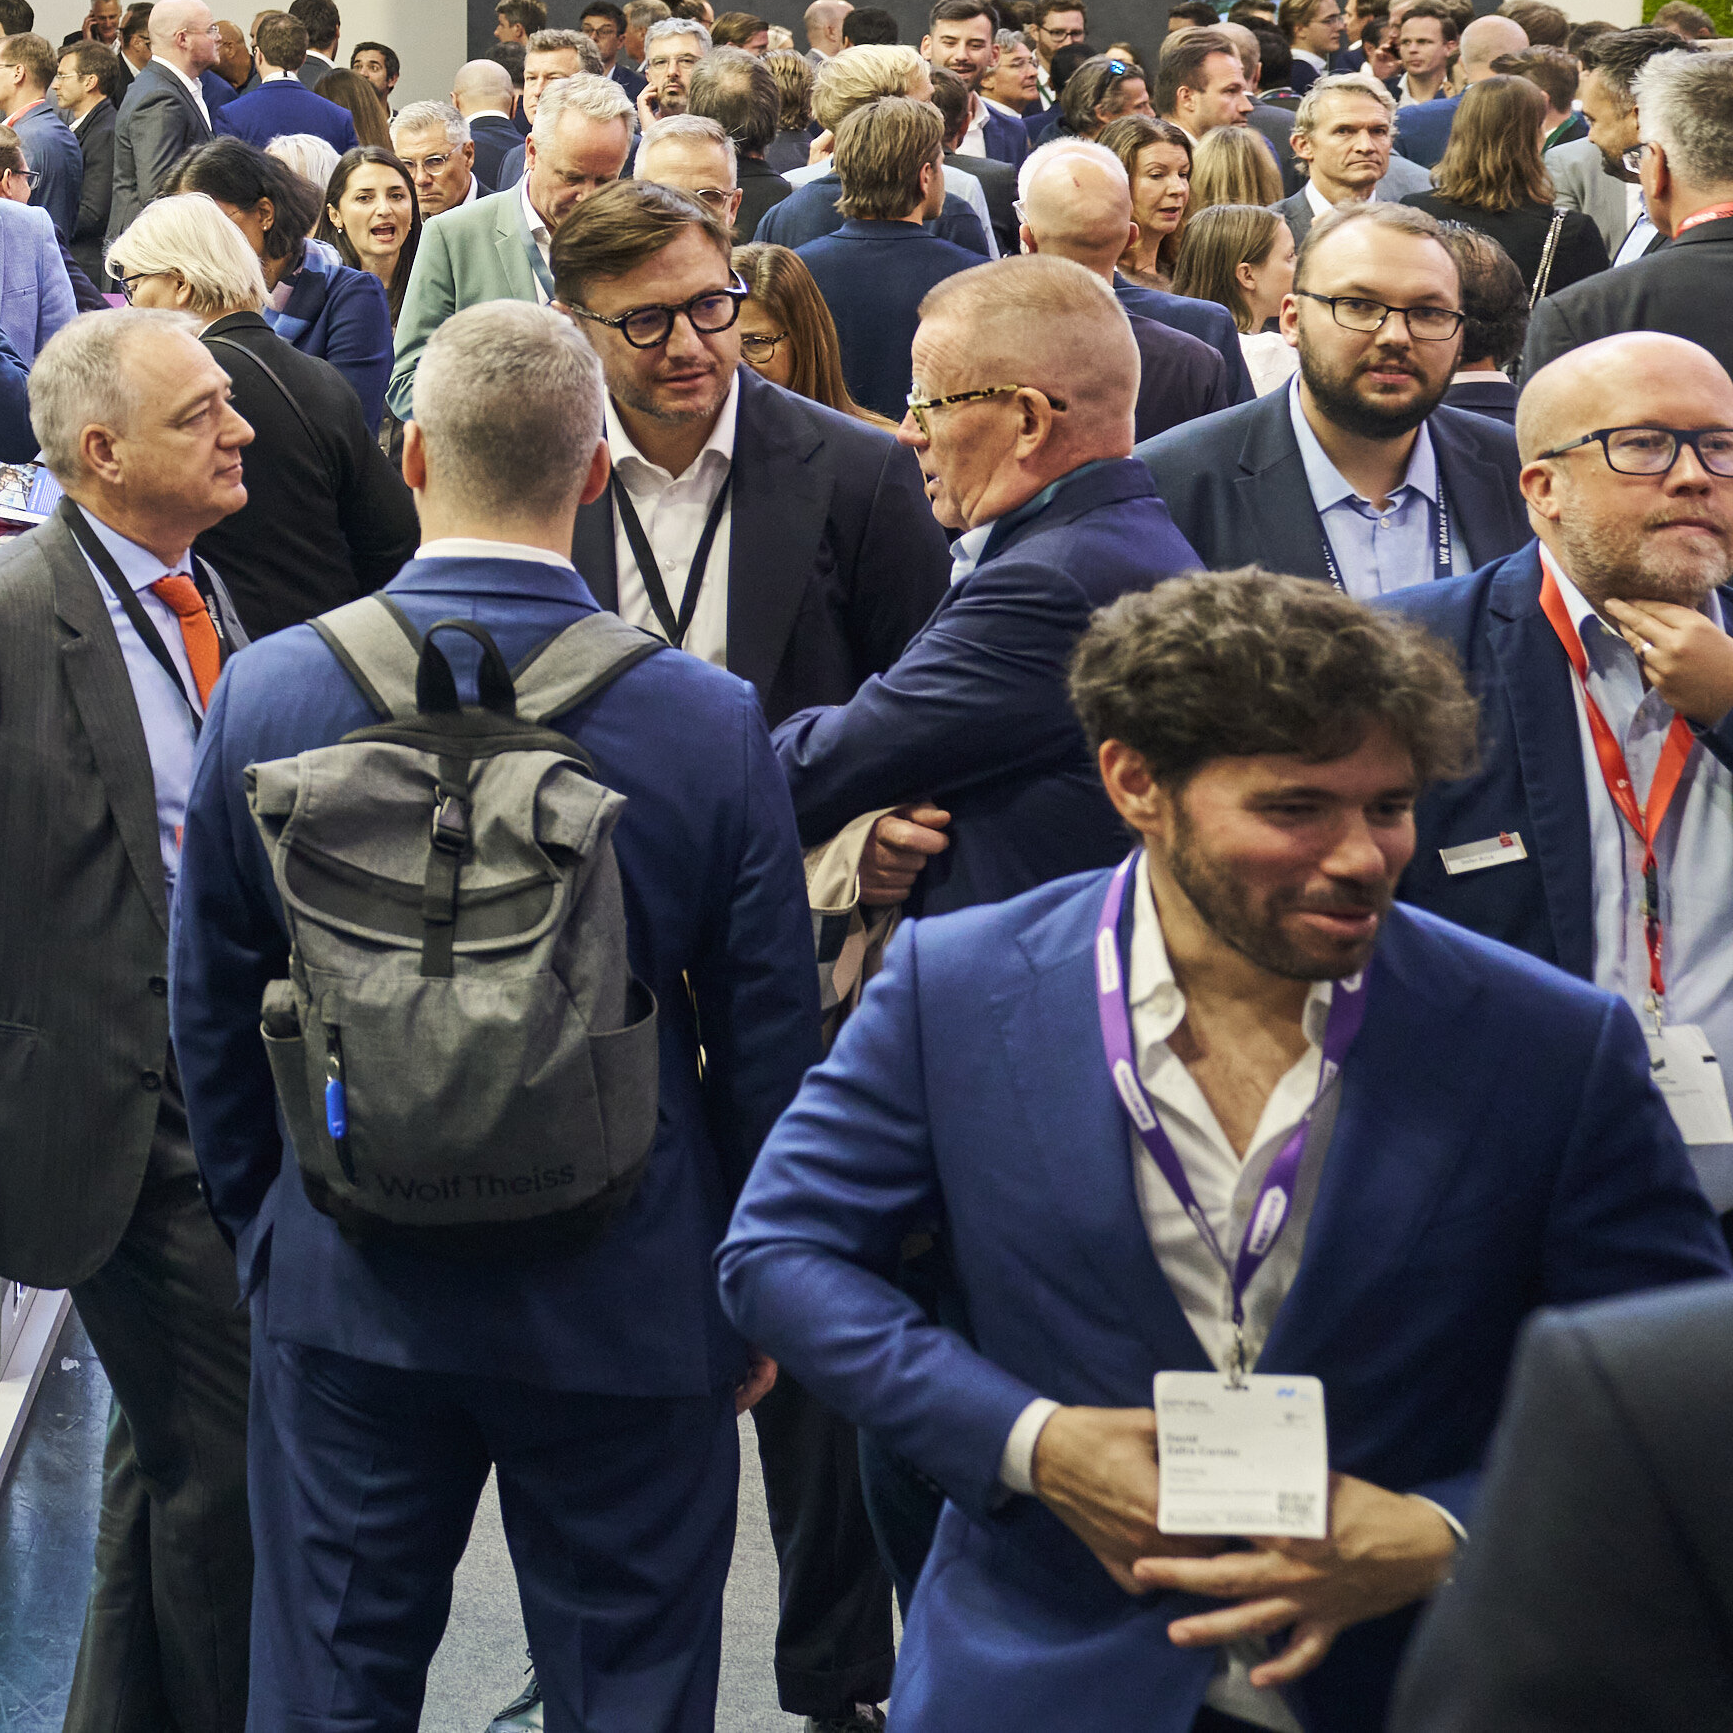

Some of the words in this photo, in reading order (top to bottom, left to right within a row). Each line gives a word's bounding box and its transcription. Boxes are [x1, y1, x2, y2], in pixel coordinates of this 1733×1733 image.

[1439, 547, 1450, 565] WE
[376, 1172, 461, 1203] Wolf
[473, 1163, 576, 1196] Theiss
